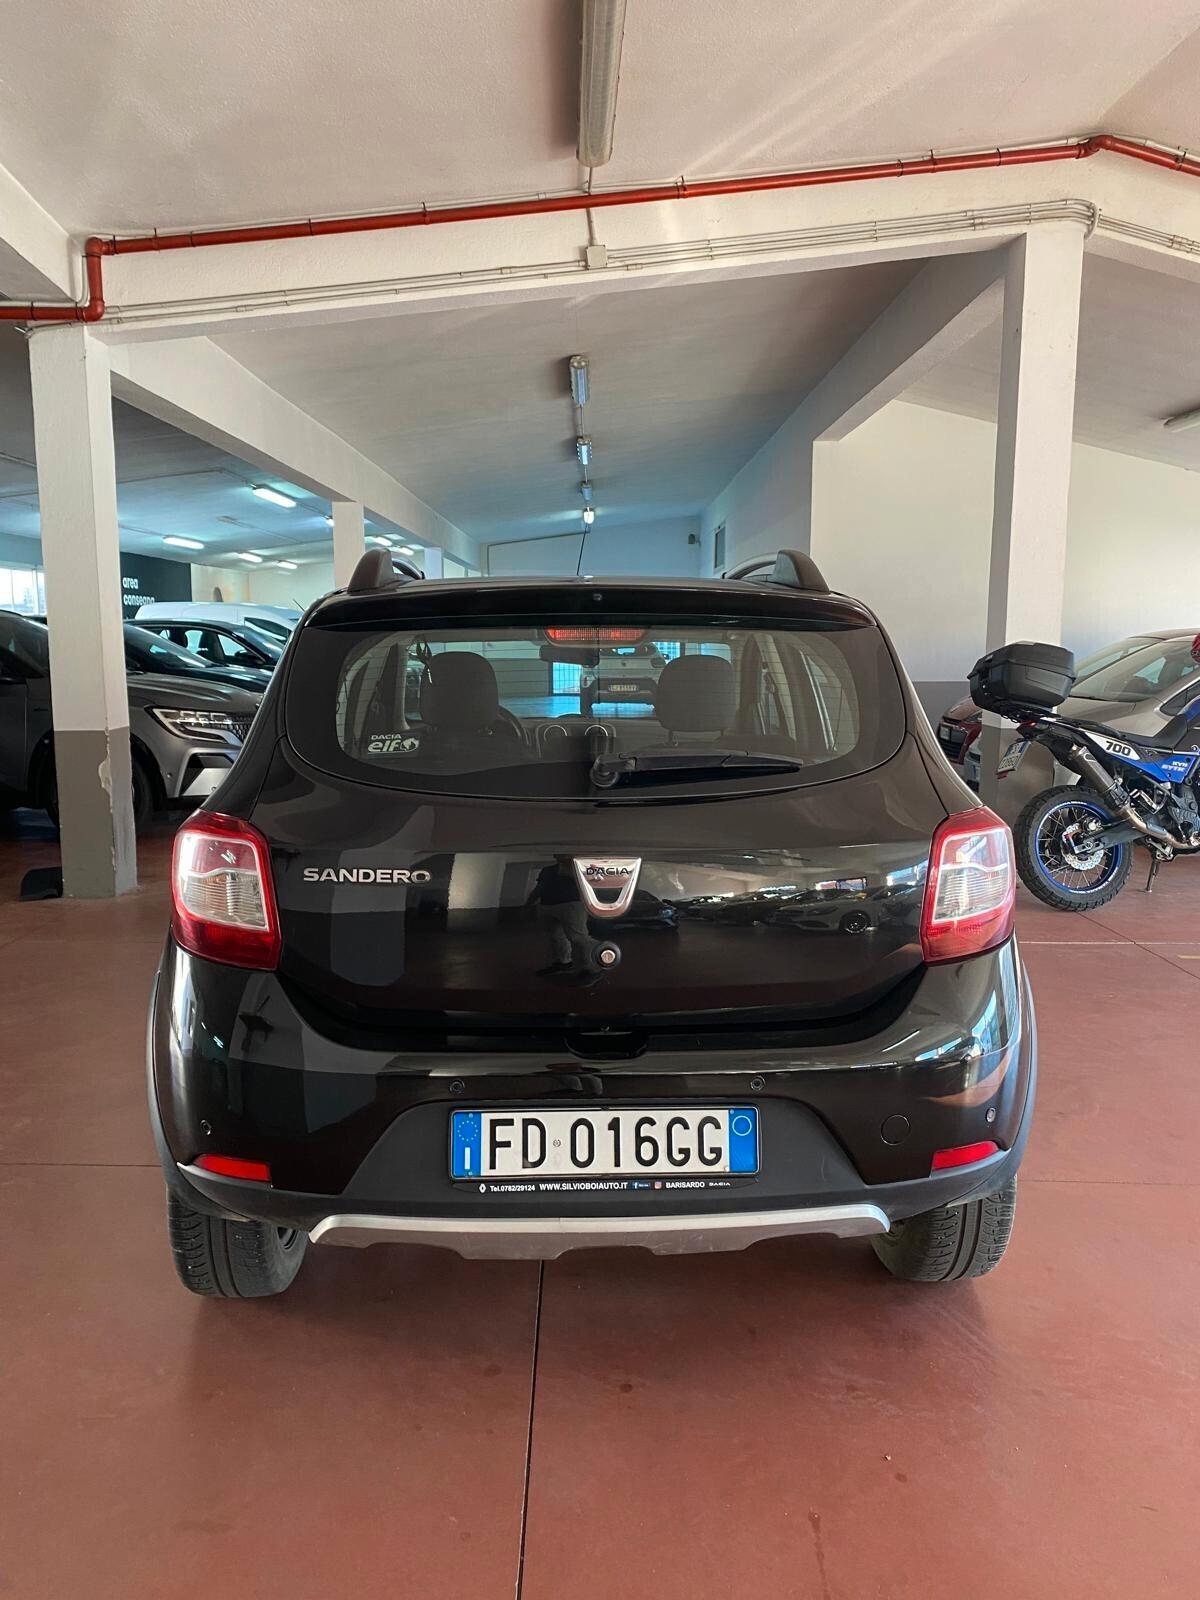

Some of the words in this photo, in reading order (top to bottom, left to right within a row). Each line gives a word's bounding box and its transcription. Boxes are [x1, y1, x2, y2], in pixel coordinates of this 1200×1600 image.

[122, 577, 139, 589] area
[368, 740, 401, 752] elf
[1105, 740, 1131, 756] 700
[303, 868, 431, 884] SANDERO
[586, 867, 630, 876] DACIA
[489, 1118, 547, 1170] FD
[570, 1115, 723, 1168] 016GG
[539, 1182, 628, 1191] WWW.SILVIOBOIAUTO.IT
[665, 1181, 706, 1189] BARISARDO
